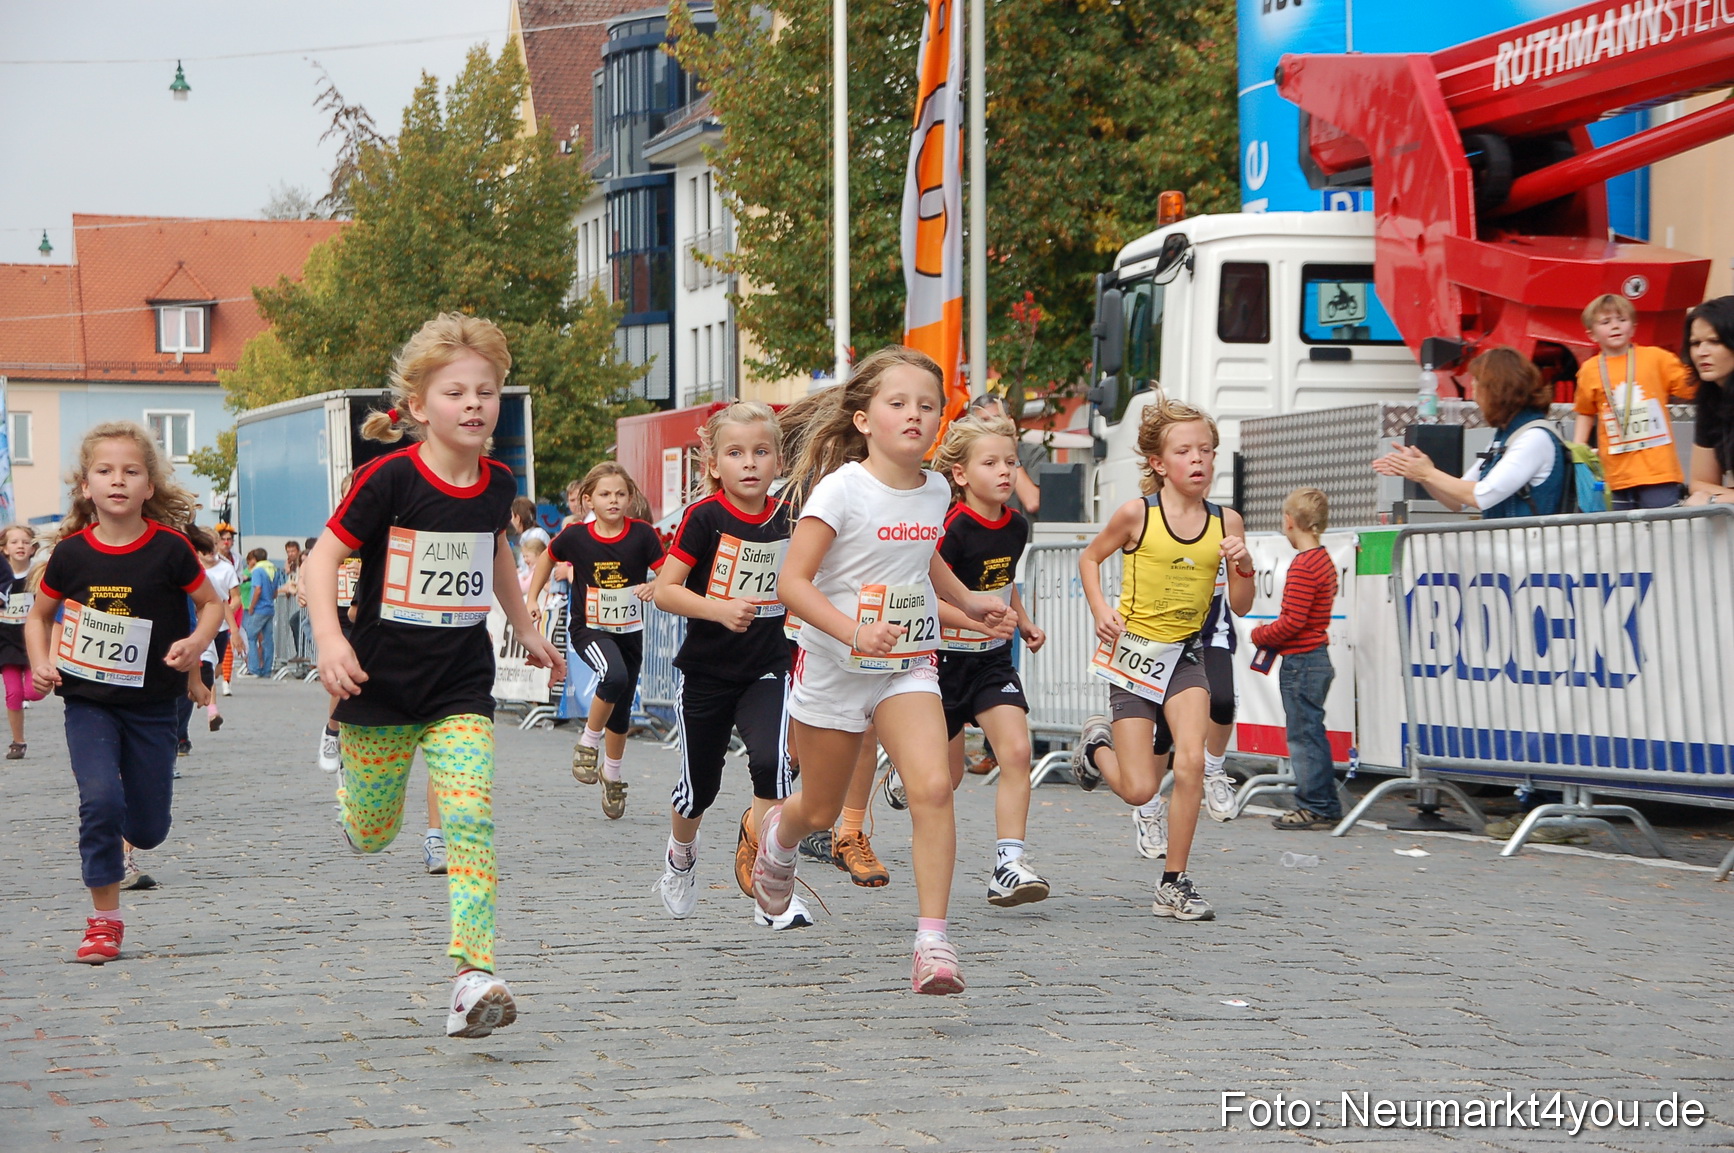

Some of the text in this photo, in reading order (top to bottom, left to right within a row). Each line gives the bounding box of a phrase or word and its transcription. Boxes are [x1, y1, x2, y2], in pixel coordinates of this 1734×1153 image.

[877, 522, 938, 541] adidas
[422, 541, 470, 562] ALINA
[742, 547, 776, 565] Sidney
[715, 562, 728, 576] K3
[420, 570, 484, 597] 7269
[738, 570, 780, 593] 712
[601, 594, 618, 602] Nina
[889, 592, 926, 610] Luciana
[602, 604, 637, 619] 7173
[63, 625, 74, 638] K3
[82, 611, 126, 635] Hannah
[1405, 572, 1653, 689] BOCK
[80, 634, 139, 664] 7120
[1118, 645, 1166, 681] 7052
